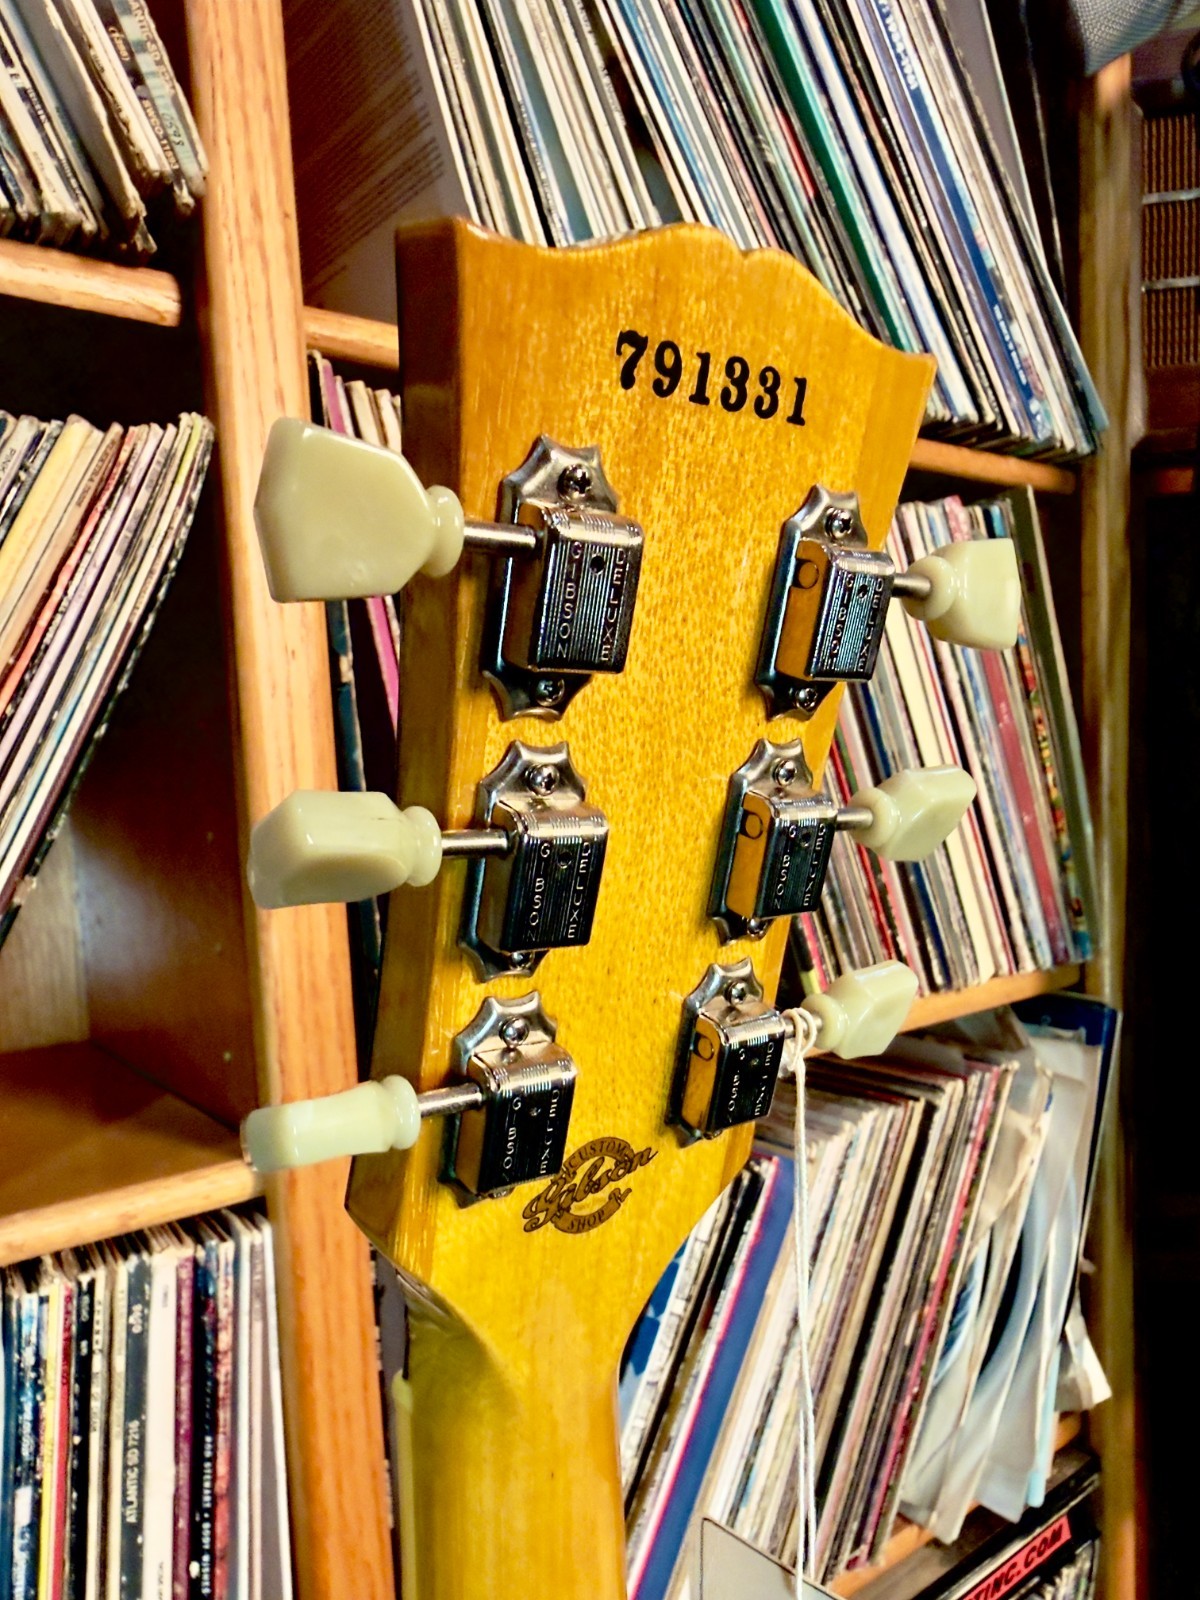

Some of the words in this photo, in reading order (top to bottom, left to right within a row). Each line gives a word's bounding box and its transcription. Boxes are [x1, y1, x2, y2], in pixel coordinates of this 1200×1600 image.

[615, 329, 807, 426] 791331
[556, 541, 582, 658] GIBSON
[601, 547, 626, 661] DELUXE
[827, 573, 854, 670] GIBSON
[858, 578, 884, 672] DELUXE
[527, 842, 551, 941] GIBSON
[568, 842, 591, 938] DELUXE
[774, 825, 797, 909] GIBSON
[727, 1048, 746, 1123] GBSO
[540, 1089, 560, 1174] DELUXE
[567, 1140, 627, 1168] CUSTOM
[522, 1146, 658, 1233] Gibson
[567, 1209, 605, 1230] SHOP
[201, 1461, 212, 1508] STEWART
[203, 1435, 213, 1458] ROD
[126, 1466, 139, 1523] ATLANTIC
[201, 1522, 211, 1549] BODY
[200, 1553, 212, 1597] WISHES
